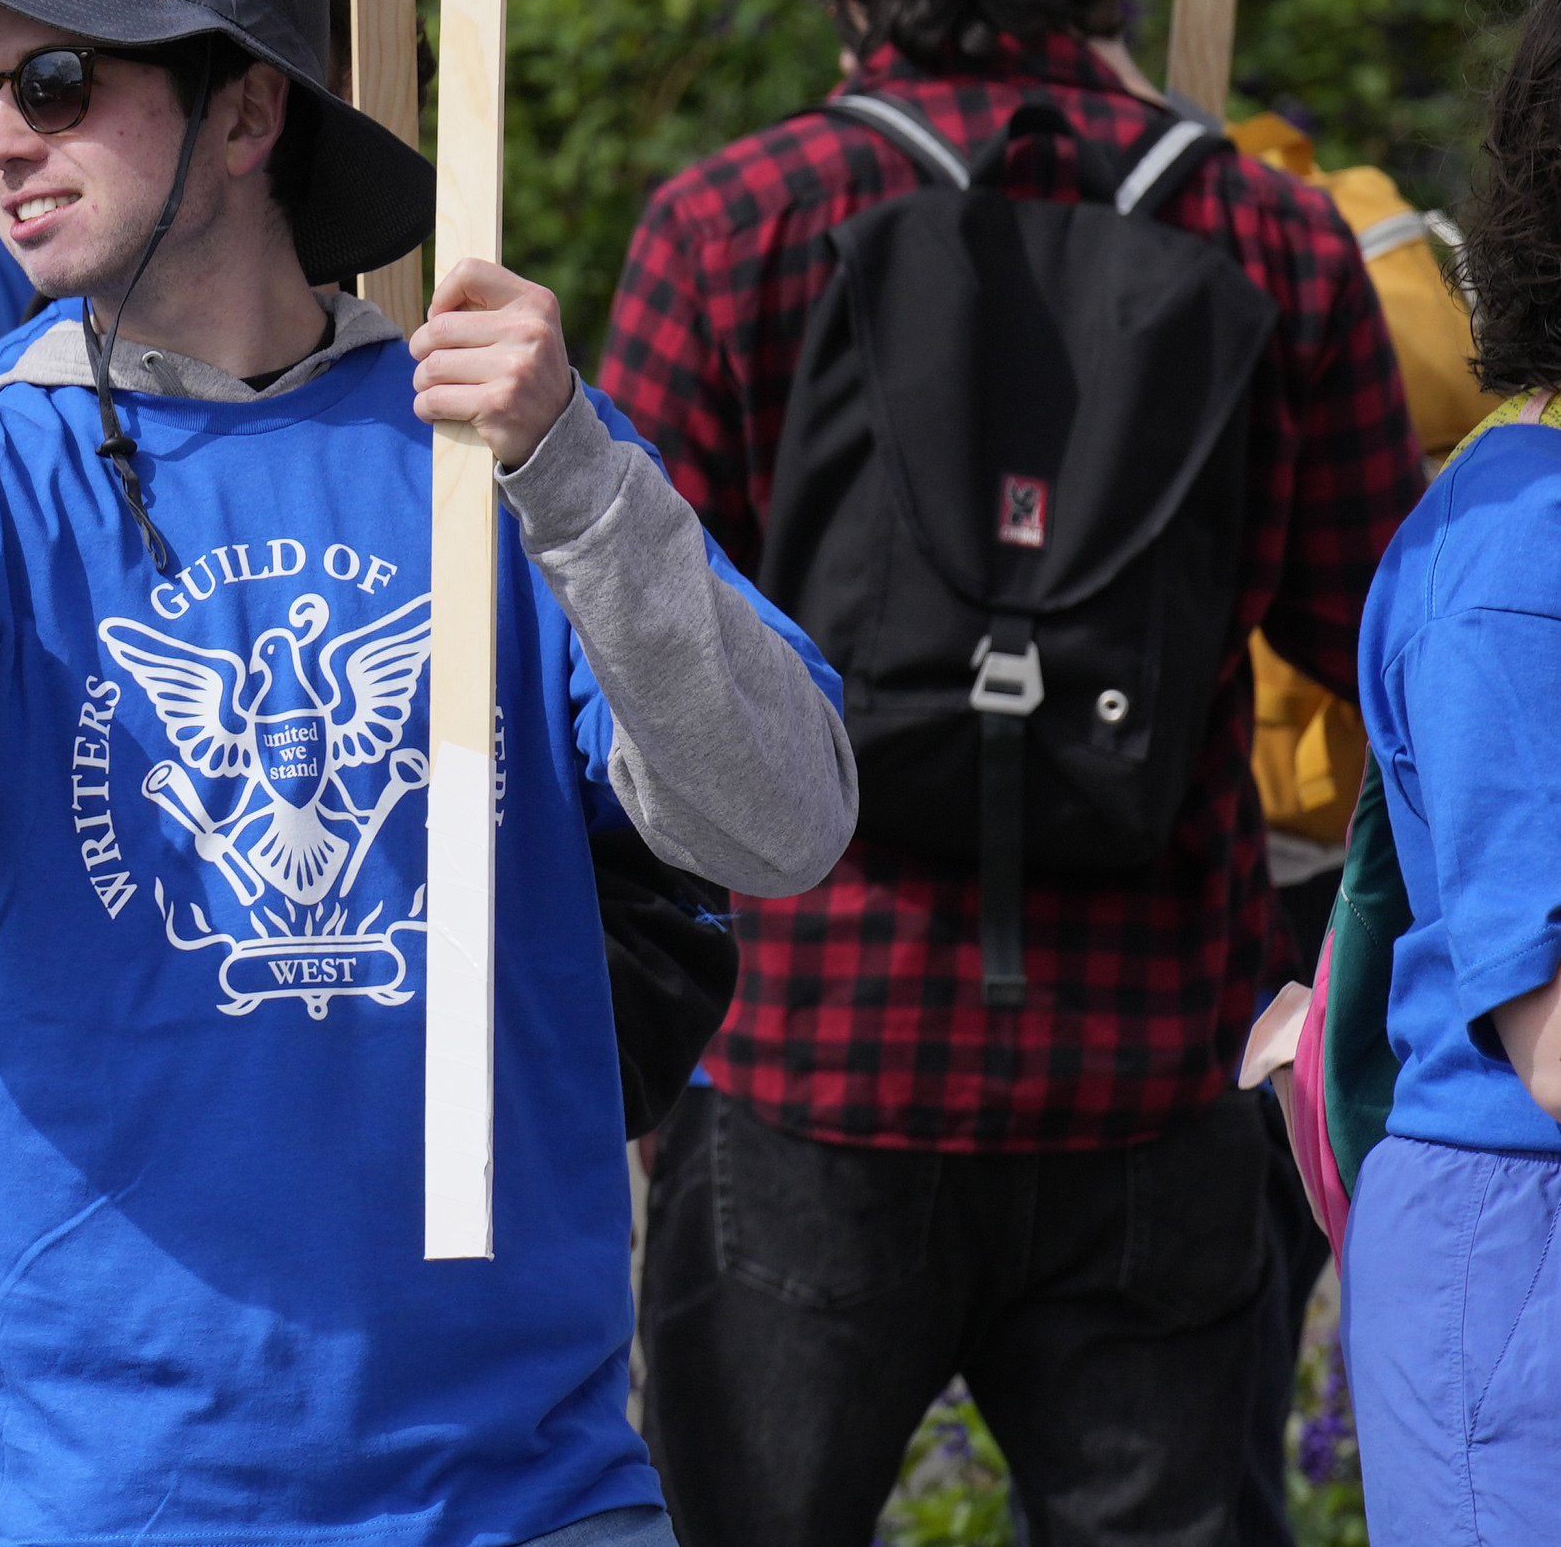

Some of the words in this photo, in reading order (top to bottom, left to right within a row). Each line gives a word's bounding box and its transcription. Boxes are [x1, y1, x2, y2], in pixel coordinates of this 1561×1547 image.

[72, 674, 138, 921] WRITERS
[149, 537, 306, 620] GUILD
[322, 542, 397, 595] OF
[262, 721, 320, 749] united
[279, 744, 308, 762] we
[269, 757, 320, 781] stand
[267, 957, 357, 985] WEST
